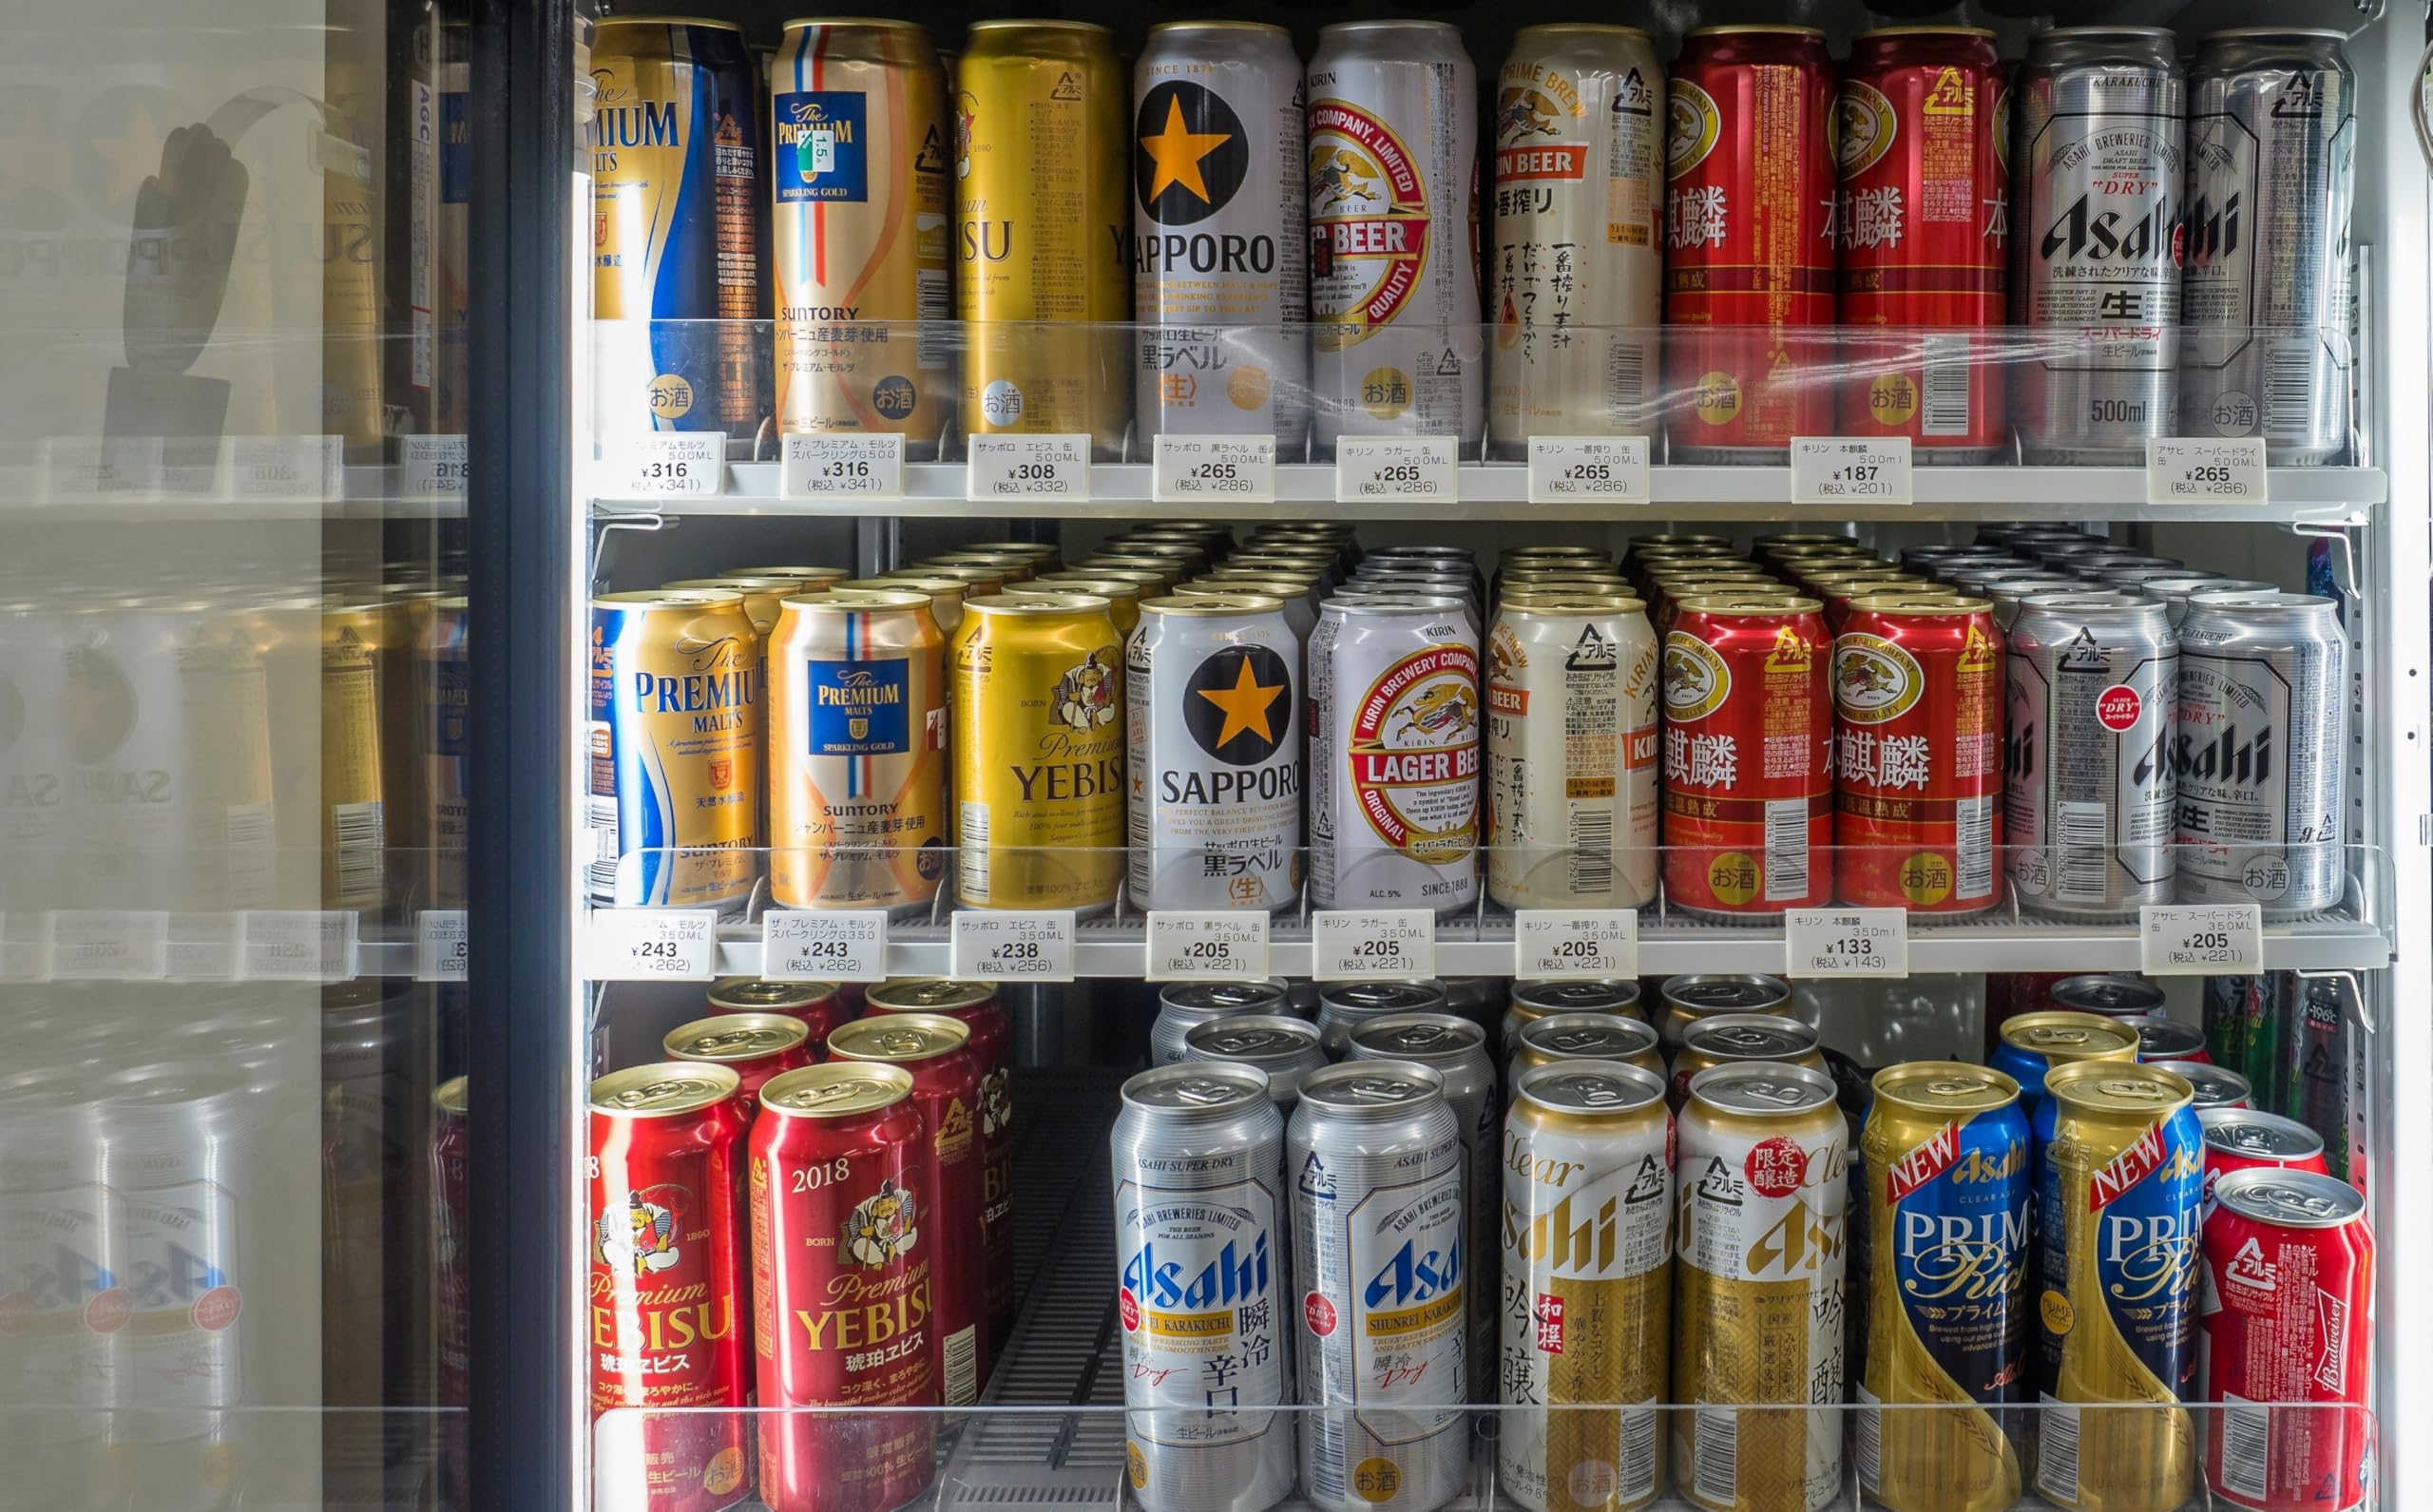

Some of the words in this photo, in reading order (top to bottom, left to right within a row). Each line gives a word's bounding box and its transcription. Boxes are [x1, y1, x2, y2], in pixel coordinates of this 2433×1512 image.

[1504, 61, 1544, 85] PRIME
[1543, 71, 1590, 120] BREW
[2062, 144, 2091, 171] ASAHI
[2095, 132, 2151, 151] BREWERIES
[2153, 141, 2177, 174] LIMITED
[1372, 136, 1414, 192] LIMITED
[1517, 151, 1574, 174] BEER
[820, 188, 849, 198] GOLD
[1339, 204, 1368, 214] BEER
[1333, 221, 1408, 254] BEER
[1136, 234, 1274, 274] APPORO
[1369, 262, 1413, 318] QUALITY
[1550, 242, 1577, 349] 一番搾り麦汁
[2100, 291, 2143, 320] 生
[1142, 345, 1227, 370] 黒ラベル
[876, 387, 913, 409] お酒
[1365, 384, 1408, 405] お酒
[1871, 389, 1913, 410] お酒
[2091, 400, 2147, 423] 500ml
[2213, 404, 2254, 427] お酒
[978, 443, 1015, 451] サッポロ
[1026, 443, 1053, 451] エビス
[1063, 443, 1072, 451] 缶
[1163, 443, 1200, 451] サッポロ
[1212, 444, 1248, 453] 黒ラベル
[1258, 444, 1268, 454] 缶
[1345, 448, 1374, 457] キリン
[1385, 447, 1411, 455] ラガー
[1421, 446, 1430, 455] 缶
[1536, 445, 1564, 454] キリン
[1574, 445, 1610, 453] 一番搾り
[1620, 445, 1631, 454] 缶
[1802, 445, 1830, 453] キリン
[2156, 446, 2185, 455] アサヒ
[2194, 448, 2255, 456] スーパードライ
[668, 451, 714, 461] 500ML
[1036, 453, 1080, 462] 500ML
[1218, 455, 1265, 465] 500ML
[1405, 456, 1447, 465] 500ML
[1594, 455, 1638, 465] 500ML
[1860, 455, 1901, 464] 500ml
[2157, 456, 2167, 466] 缶
[2212, 458, 2256, 468] 500ML
[642, 463, 687, 477] ¥316
[823, 462, 868, 476] ¥316
[1009, 465, 1054, 479] ¥308
[1192, 464, 1236, 478] ¥265
[1375, 467, 1419, 481] ¥265
[1565, 465, 1609, 479] ¥265
[1833, 467, 1878, 480] ¥187
[2186, 467, 2230, 481] ¥265
[841, 479, 881, 490] ¥341)
[1212, 480, 1253, 492] ¥286)
[1586, 480, 1627, 492] ¥286)
[2206, 483, 2247, 495] ¥286)
[1426, 624, 1456, 638] KIRIN
[837, 669, 878, 687] The
[635, 665, 757, 713] PREMIU
[818, 684, 900, 706] PREMIUM
[1361, 695, 1387, 731] KIRIN
[1380, 656, 1437, 698] BREWERY
[2217, 679, 2251, 709] LIMITED
[1491, 693, 1522, 711] BEER
[823, 742, 869, 753] SPARKLING
[871, 741, 895, 751] GOLD
[1368, 753, 1449, 782] LAGER
[1010, 758, 1121, 802] YEBIS
[823, 803, 899, 816] SUNTORY
[1365, 790, 1405, 841] ORIGINAL
[1203, 849, 1283, 877] 黒ラベル
[1712, 869, 1755, 890] お酒
[1904, 869, 1947, 890] お酒
[2243, 869, 2286, 890] お酒
[1422, 882, 1451, 897] SINCE
[1795, 917, 1822, 926] キリン
[2152, 912, 2178, 921] アサヒ
[2189, 910, 2251, 920] スーパードライ
[962, 921, 998, 930] サッポロ
[1009, 921, 1037, 929] エビス
[1047, 921, 1055, 929] 缶
[1157, 921, 1194, 929] サッポロ
[1204, 922, 1241, 930] 黒ラベル
[1252, 923, 1259, 931] 缶
[1322, 919, 1351, 928] キリン
[1361, 919, 1388, 928] ラガー
[1399, 919, 1407, 928] 缶
[1524, 922, 1551, 930] キリン
[1562, 921, 1598, 929] 一番搾り
[1610, 921, 1618, 929] 缶
[2151, 923, 2161, 932] 缶
[2209, 922, 2251, 930] 350ML
[659, 930, 705, 940] 350ML
[1020, 931, 1063, 940] 350ML
[1215, 933, 1257, 942] 350ML
[1381, 929, 1425, 938] 350ML
[1582, 931, 1626, 940] 350ML
[1853, 928, 1894, 936] 350ml
[1827, 939, 1871, 954] ¥133
[2183, 933, 2228, 947] ¥205
[631, 942, 677, 957] ¥243
[802, 942, 847, 957] ¥243
[992, 943, 1038, 958] ¥238
[1184, 943, 1229, 957] ¥205
[1353, 941, 1399, 955] ¥205
[1553, 942, 1598, 956] ¥205
[1010, 960, 1051, 972] ¥256)
[1371, 958, 1413, 969] ¥221)
[1845, 956, 1886, 968] ¥143)
[1169, 1158, 1209, 1172] SUPER
[1212, 1156, 1236, 1169] DRY
[1755, 1146, 1798, 1170] 限定
[1887, 1120, 1960, 1198] NEW
[2093, 1119, 2164, 1206] NEW
[792, 1158, 851, 1194] 2018
[1753, 1168, 1799, 1190] 醸造
[1158, 1207, 1207, 1223] BREWERIES
[1208, 1208, 1241, 1233] LIMITED
[686, 1229, 711, 1242] 1890
[1901, 1199, 2030, 1264] PRIM
[805, 1237, 835, 1248] BORN
[1123, 1228, 1269, 1310] Asahi
[591, 1293, 733, 1352] EBISU
[1164, 1315, 1231, 1331] KARAKUCHI
[1369, 1312, 1420, 1331] SHUNREI
[2322, 1299, 2342, 1391] Budweiser
[1357, 1470, 1398, 1492] お酒
